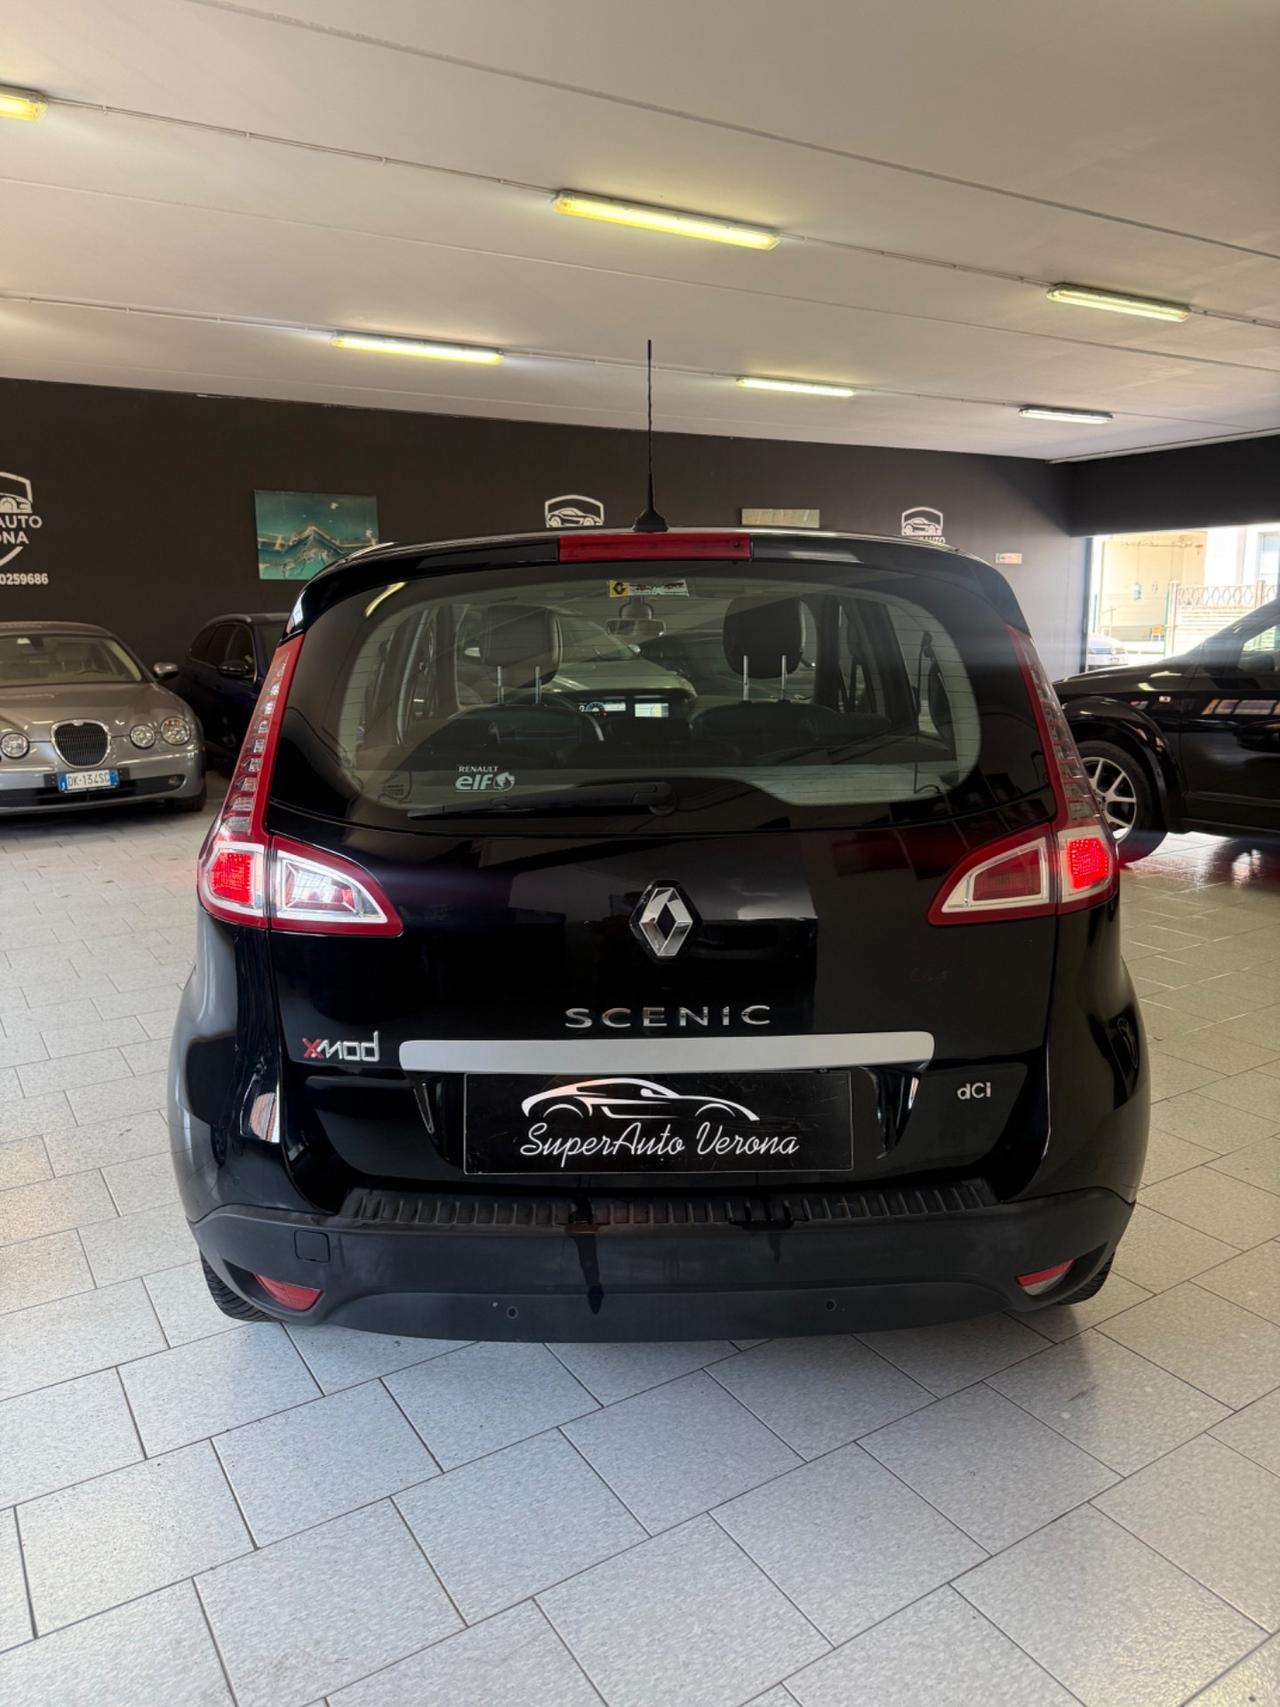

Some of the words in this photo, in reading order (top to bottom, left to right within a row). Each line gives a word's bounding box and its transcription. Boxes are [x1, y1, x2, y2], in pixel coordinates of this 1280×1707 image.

[0, 531, 30, 545] NA
[455, 773, 494, 791] elf
[565, 1005, 771, 1029] SCENIC
[520, 1121, 686, 1168] SuperAuto
[696, 1121, 800, 1155] Verona
